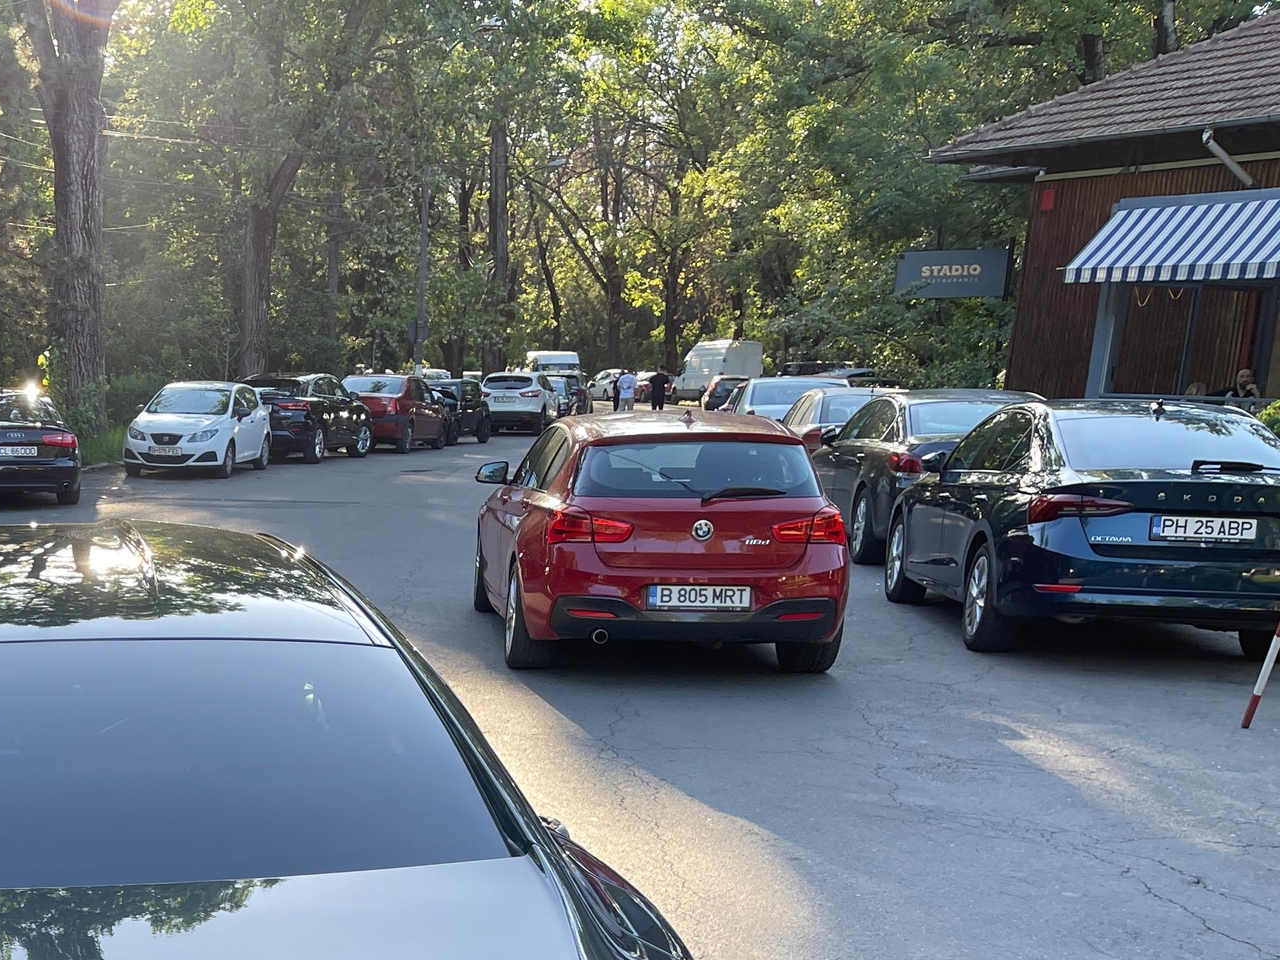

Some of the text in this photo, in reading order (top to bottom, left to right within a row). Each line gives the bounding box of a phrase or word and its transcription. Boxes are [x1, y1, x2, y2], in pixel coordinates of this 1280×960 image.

[921, 264, 981, 277] STADIO
[1162, 518, 1188, 535] PH
[1194, 520, 1215, 535] 25
[1217, 520, 1253, 537] ABP
[660, 588, 672, 604] B
[677, 587, 708, 604] 805
[713, 588, 746, 605] MRT
